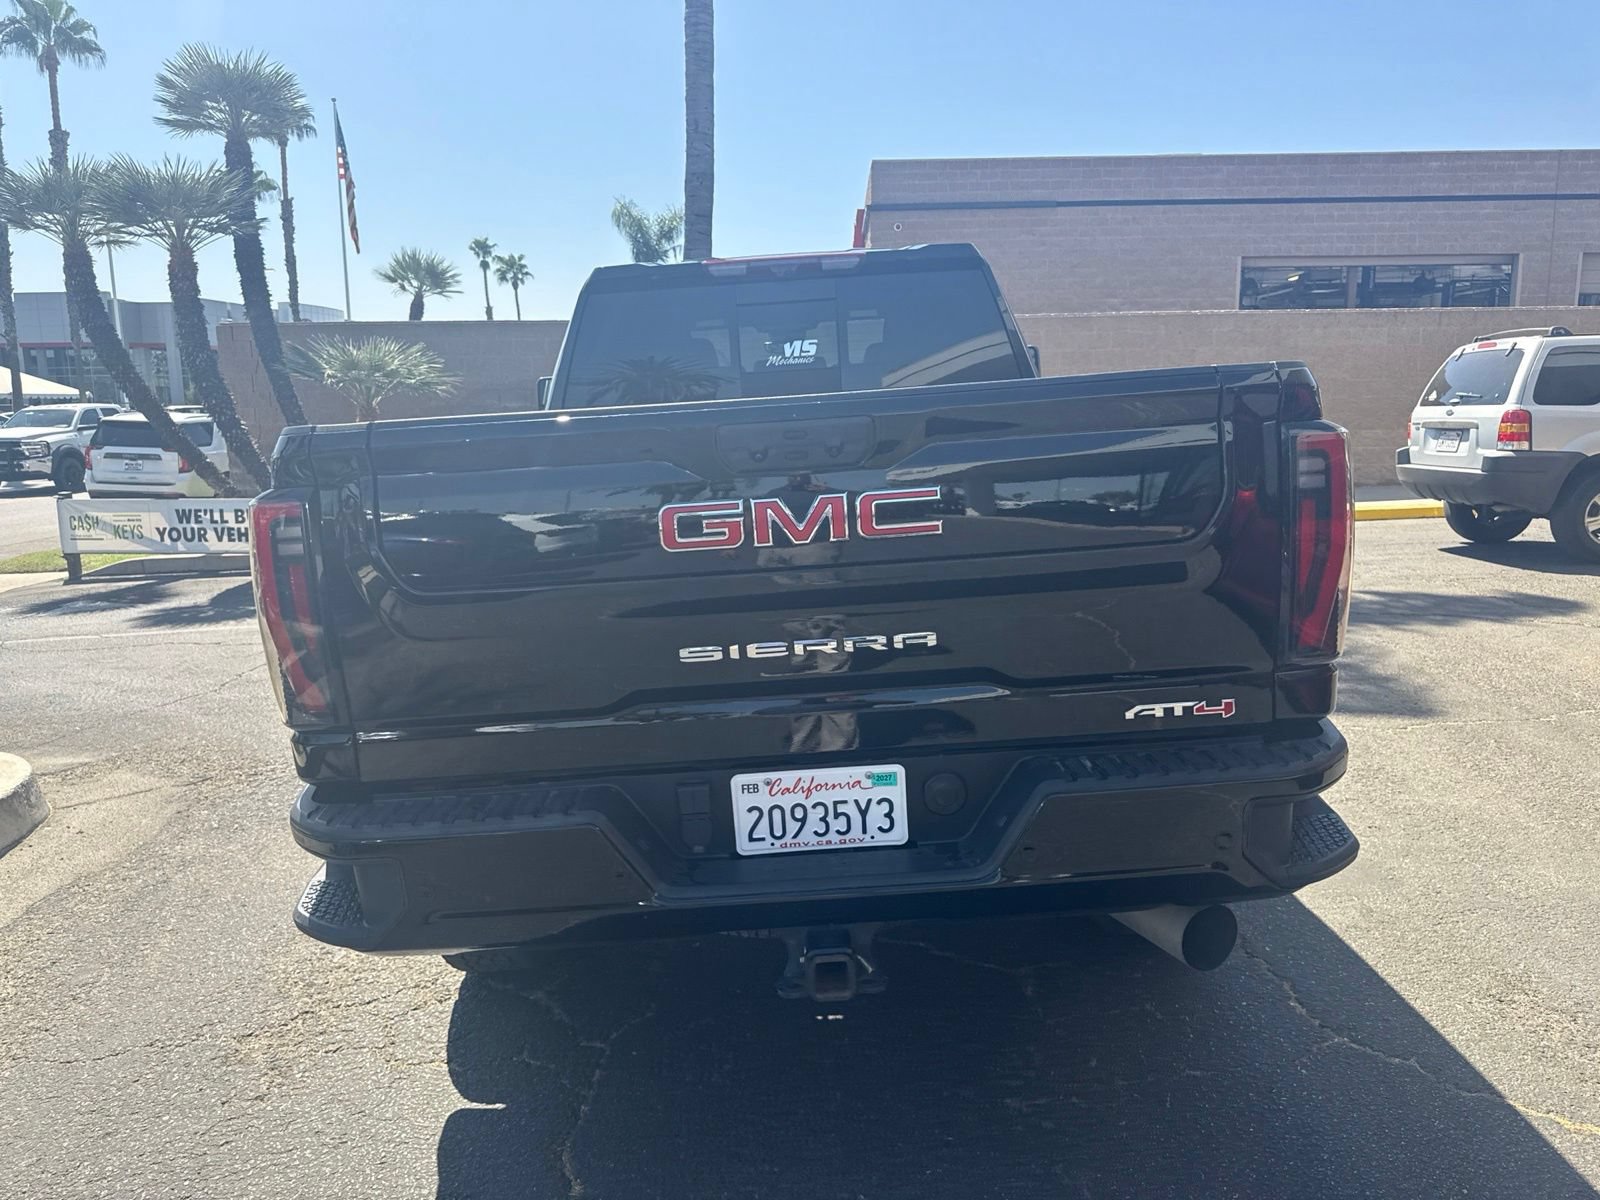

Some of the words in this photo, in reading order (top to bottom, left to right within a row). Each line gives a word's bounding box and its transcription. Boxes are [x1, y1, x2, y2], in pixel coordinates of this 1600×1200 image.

[765, 354, 815, 367] Mechanics
[174, 508, 229, 525] WE'LL
[234, 508, 249, 525] B
[658, 485, 943, 552] GMC
[113, 524, 144, 540] KEYS
[154, 526, 209, 543] YOUR
[678, 631, 938, 663] SIERRA
[1124, 698, 1236, 720] AT4
[741, 783, 760, 795] FEB
[767, 774, 875, 800] California
[875, 774, 893, 782] 2027
[746, 797, 895, 843] 20935Y3
[779, 836, 866, 849] dmv.ca.gov
